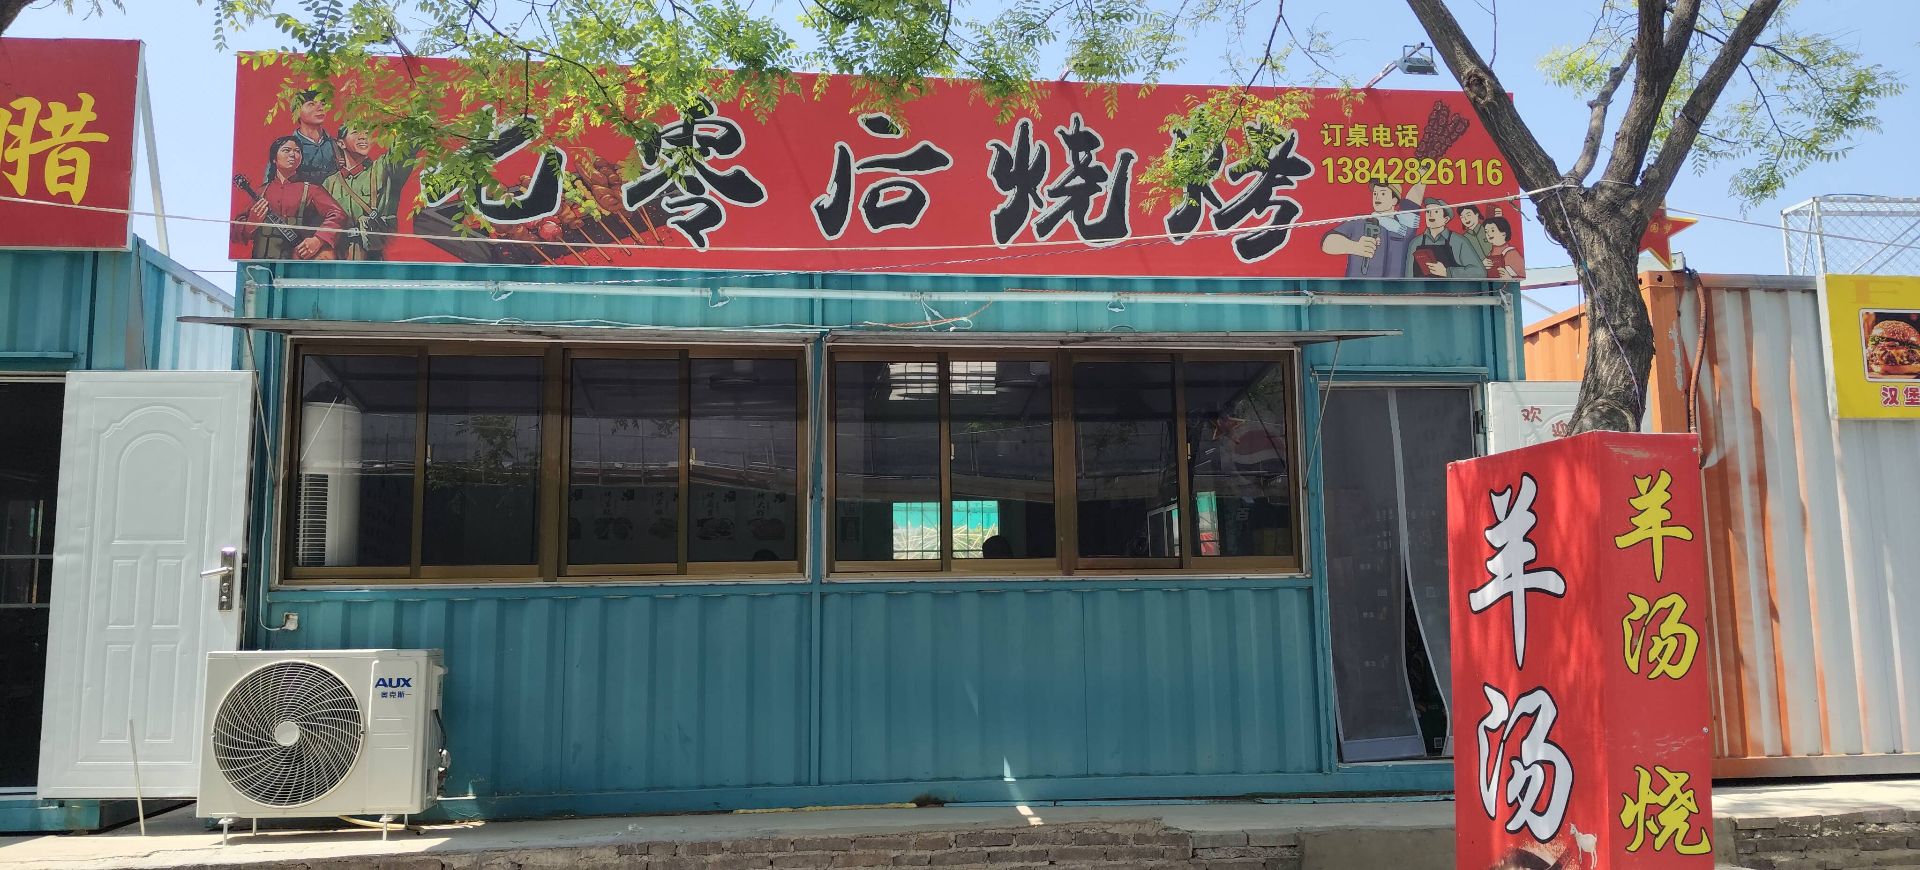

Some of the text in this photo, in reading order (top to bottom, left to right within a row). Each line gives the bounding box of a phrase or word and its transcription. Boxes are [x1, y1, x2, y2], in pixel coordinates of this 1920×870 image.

[1320, 123, 1419, 148] 订桌电话
[1321, 157, 1504, 186] 13842826116
[1880, 385, 1920, 407] 汉堡
[1468, 472, 1574, 843] 羊汤
[375, 677, 413, 689] AUX
